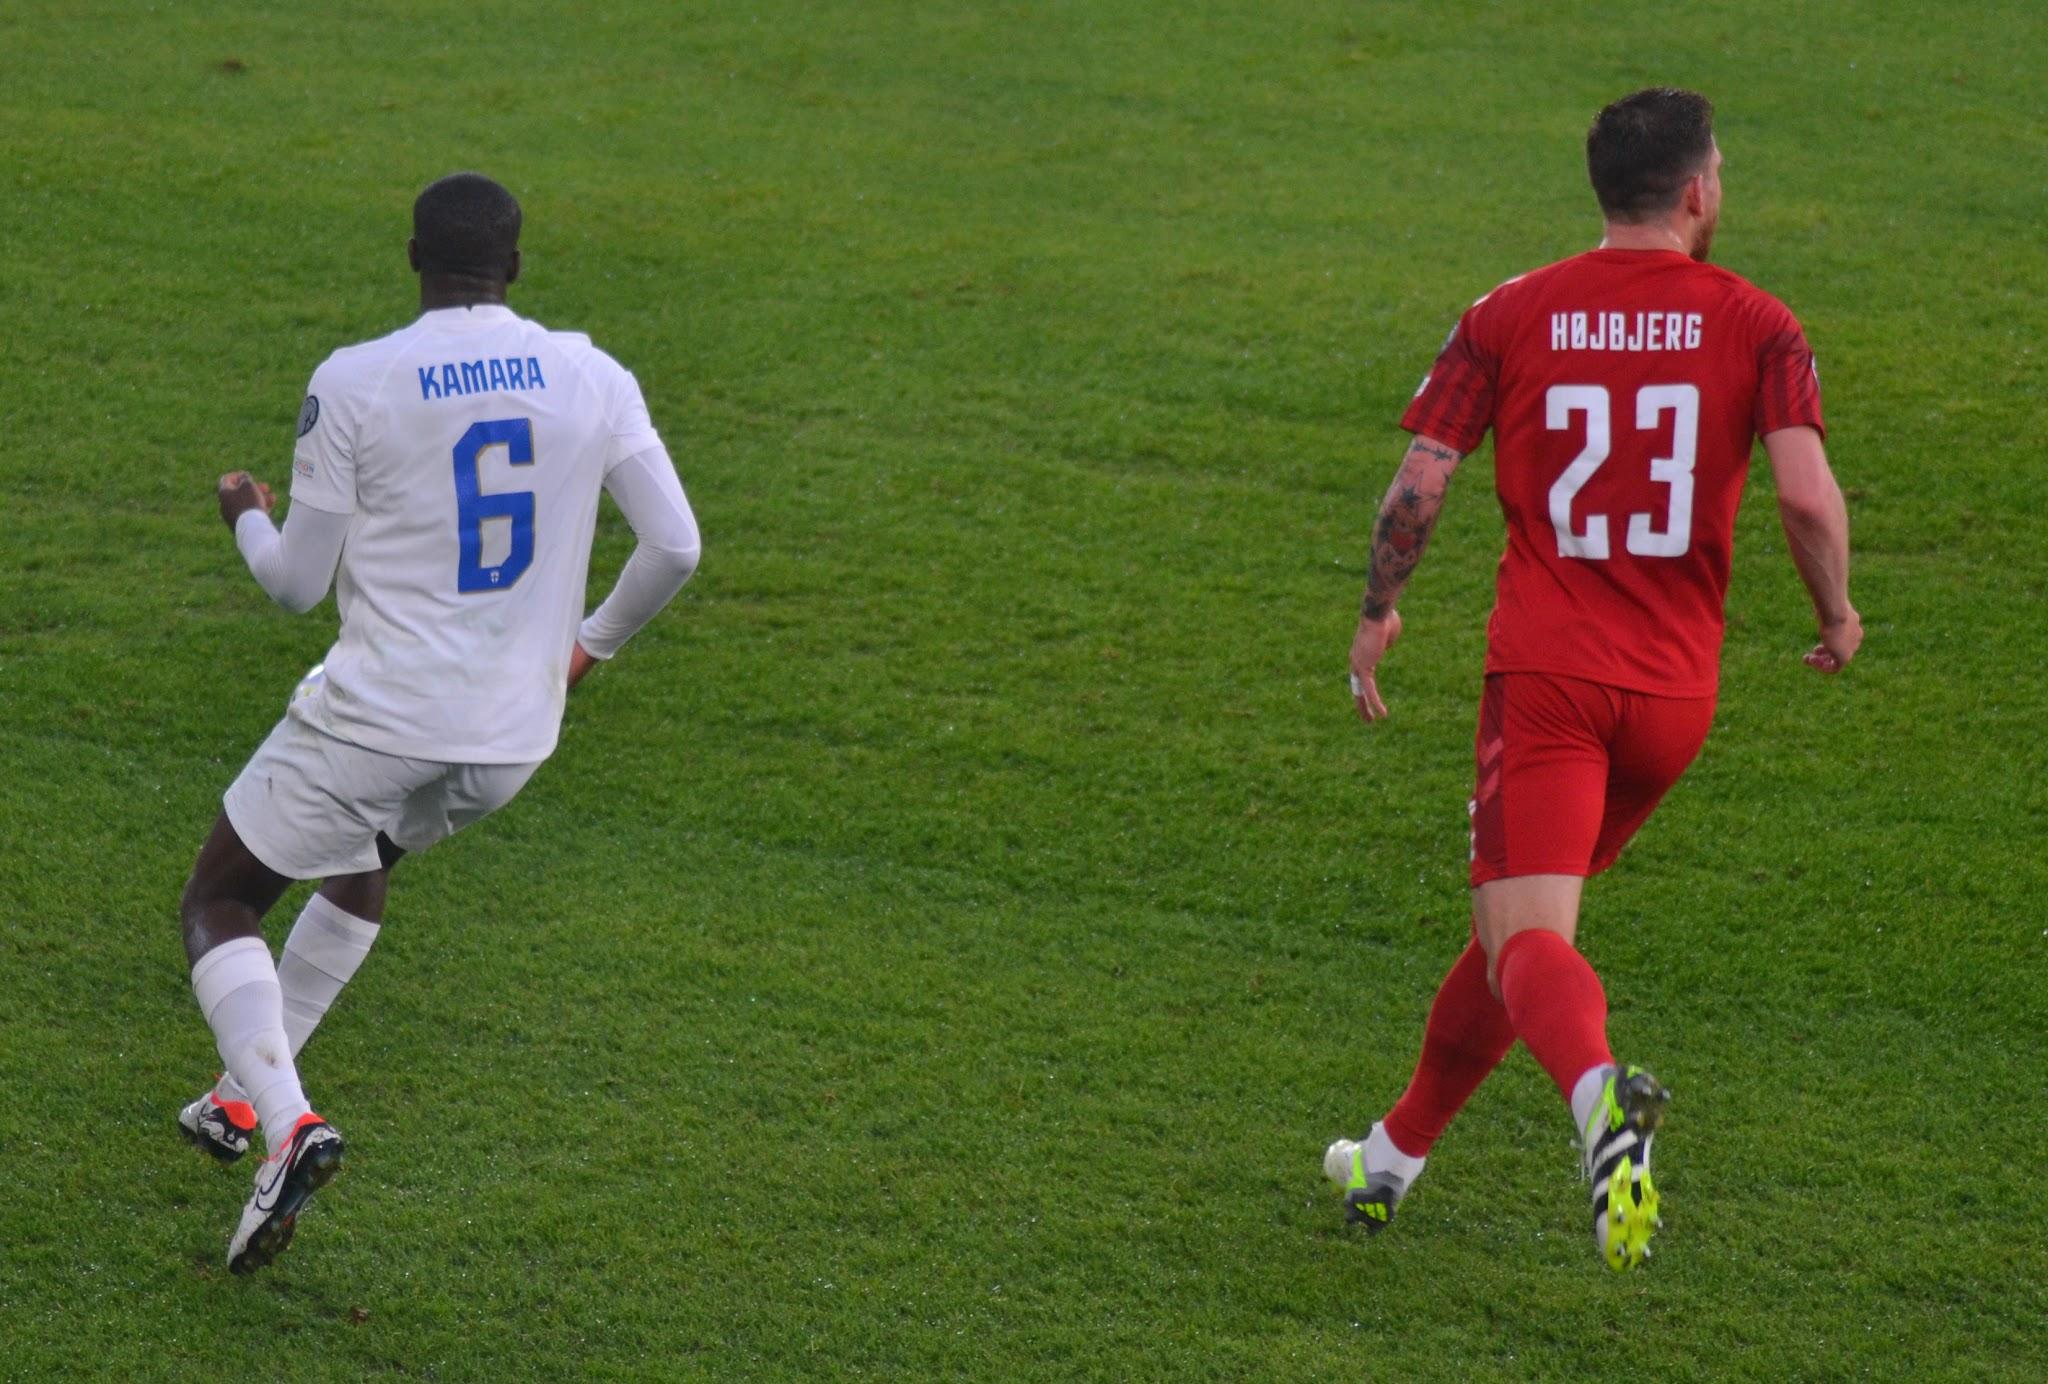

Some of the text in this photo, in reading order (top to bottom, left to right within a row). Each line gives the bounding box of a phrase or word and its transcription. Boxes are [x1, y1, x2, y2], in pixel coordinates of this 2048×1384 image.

[418, 356, 546, 400] KAMARA
[1551, 311, 1702, 351] HØJBJERG
[453, 417, 535, 594] 6
[1545, 383, 1700, 560] 23
